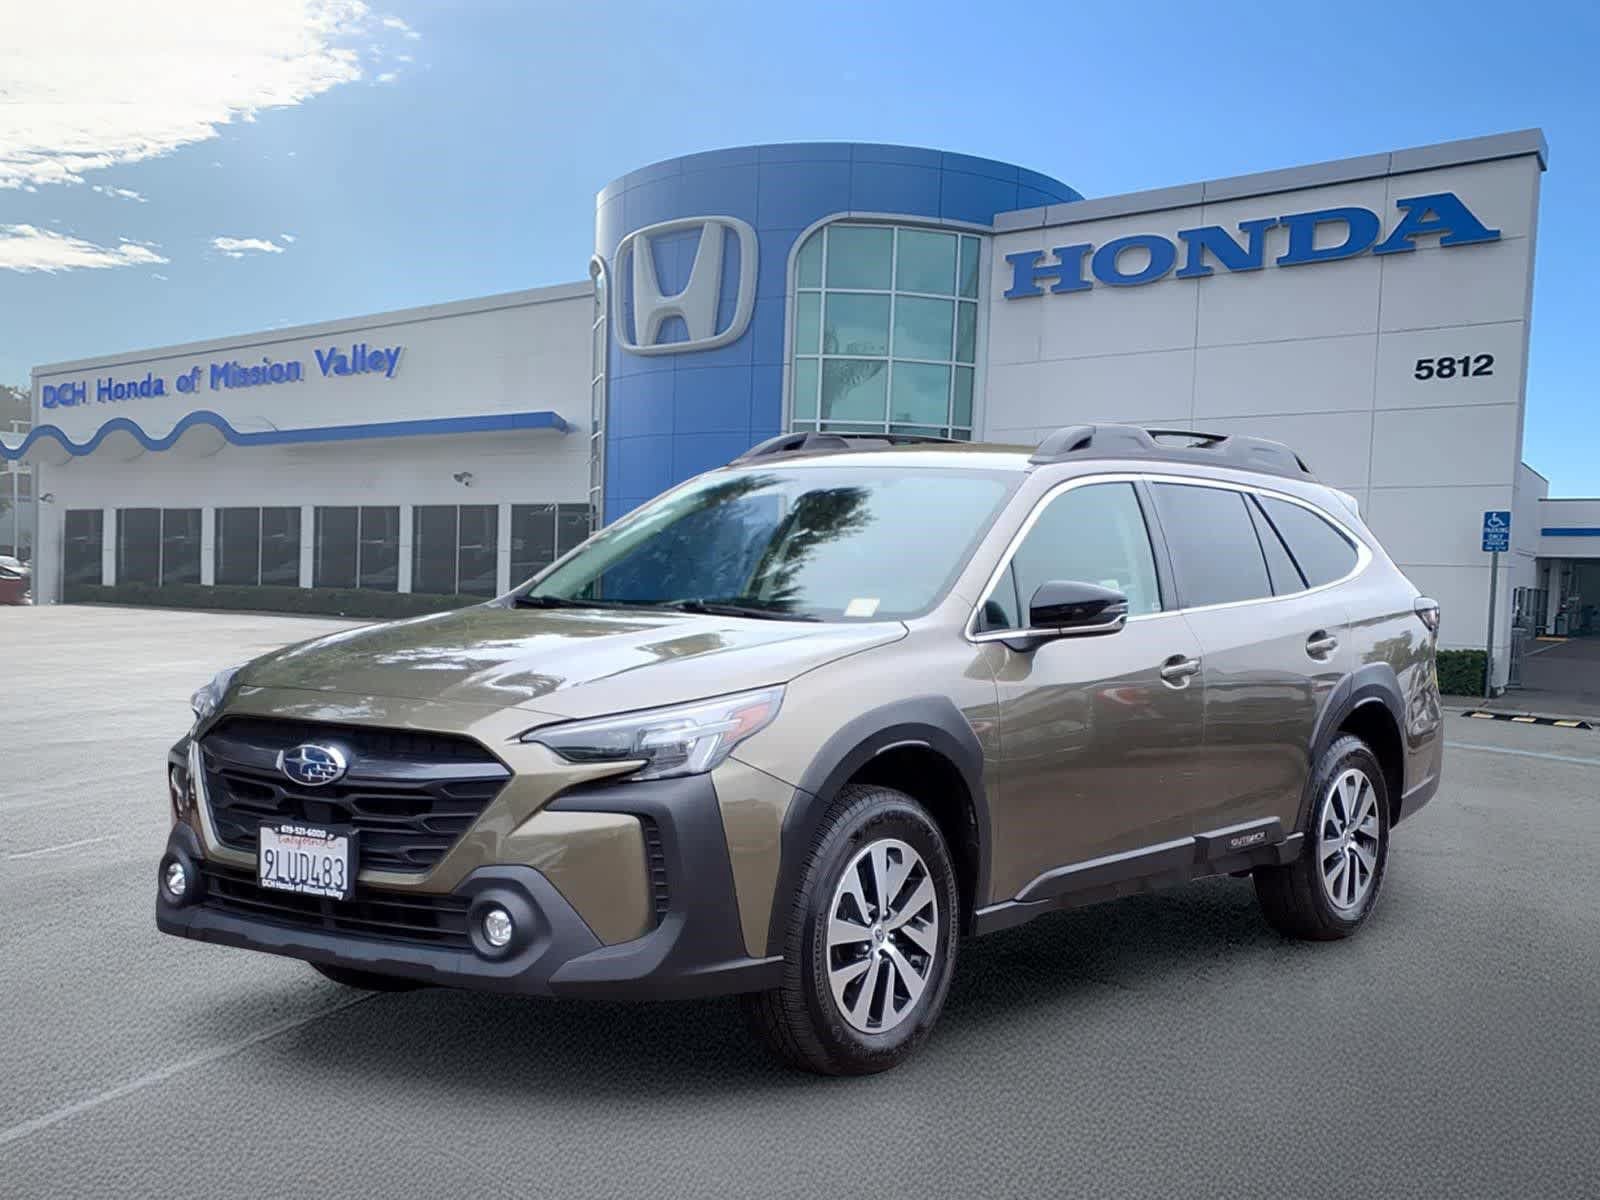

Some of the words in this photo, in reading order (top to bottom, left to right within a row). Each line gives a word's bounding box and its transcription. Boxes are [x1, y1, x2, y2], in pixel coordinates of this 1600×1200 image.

[1003, 192, 1501, 300] HONDA
[42, 381, 87, 409] DCH
[97, 372, 166, 402] Honda
[176, 366, 203, 393] of
[210, 356, 301, 391] Mission
[315, 343, 402, 378] Valley
[1414, 353, 1494, 381] 5812
[264, 849, 344, 890] 9LUD483
